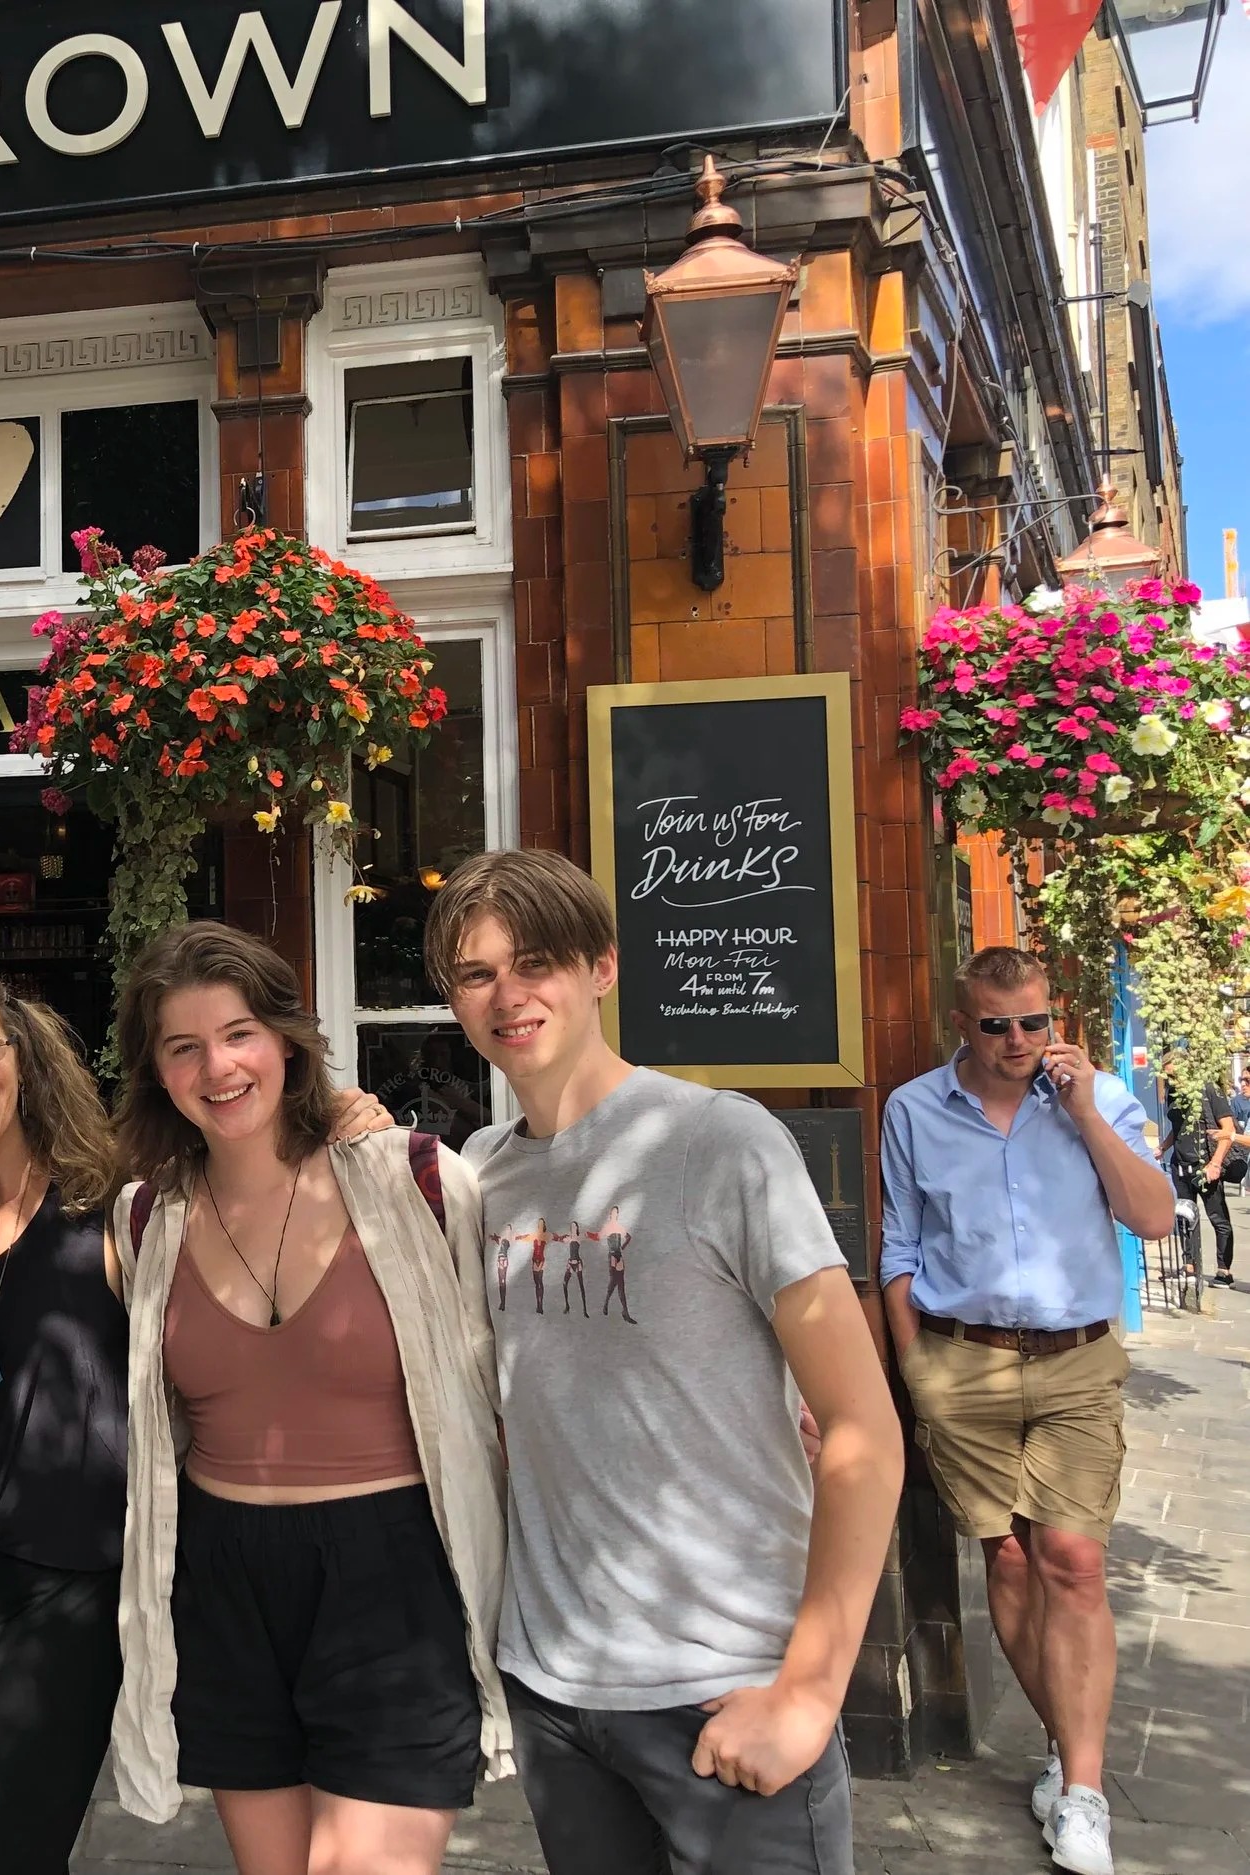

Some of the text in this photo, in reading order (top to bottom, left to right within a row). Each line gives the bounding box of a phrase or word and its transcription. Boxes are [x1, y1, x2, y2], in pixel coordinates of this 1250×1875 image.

[636, 795, 707, 841] Join
[655, 927, 798, 947] HAPPY HOUR
[706, 973, 743, 982] FROM
[718, 982, 747, 995] until
[752, 1001, 800, 1020] Holidays
[418, 1067, 474, 1098] CROWN
